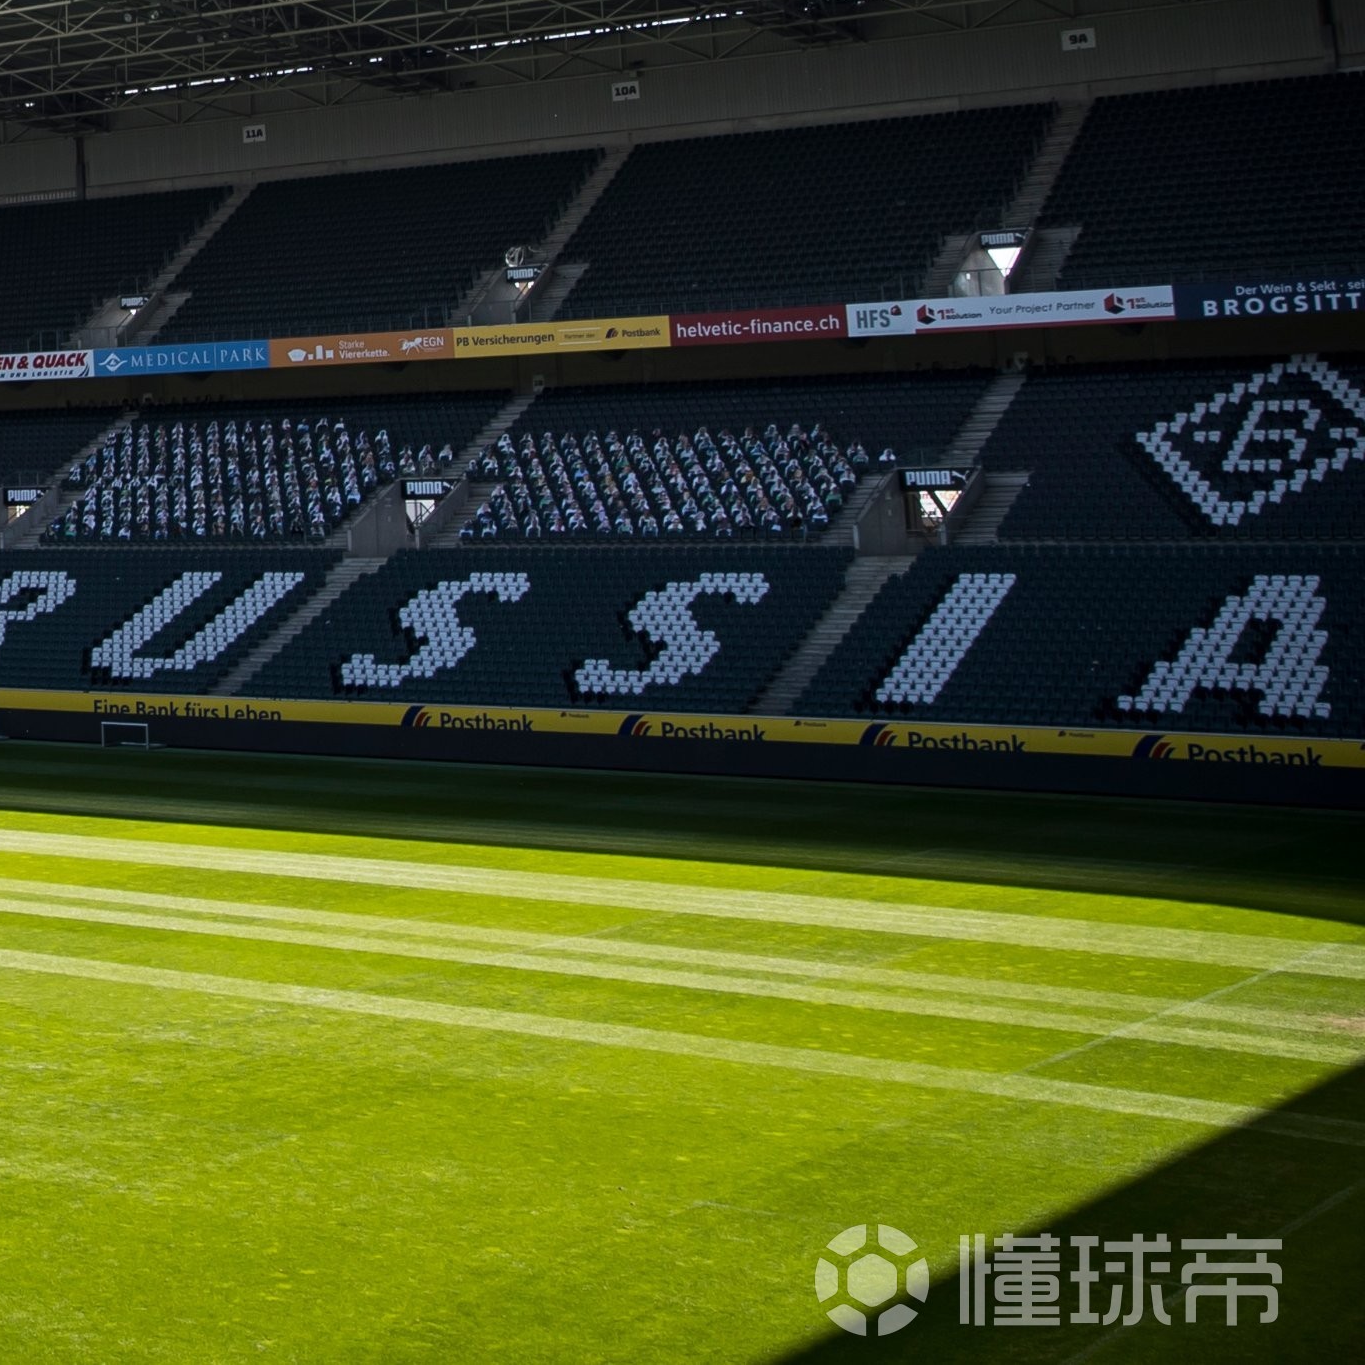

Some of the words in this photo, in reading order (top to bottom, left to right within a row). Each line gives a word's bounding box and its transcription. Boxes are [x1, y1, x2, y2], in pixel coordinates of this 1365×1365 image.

[1069, 34, 1089, 45] 9A
[614, 86, 637, 97] 10A
[245, 129, 263, 139] 11A
[1235, 285, 1258, 296] Der
[1260, 283, 1292, 295] Wein
[1296, 281, 1306, 293] &
[1309, 279, 1337, 292] Sekt
[989, 306, 1015, 316] Your
[1016, 303, 1053, 315] Project
[1055, 301, 1096, 312] Partner
[676, 314, 840, 338] helvetic-finance.ch
[856, 309, 890, 329] HFS
[456, 337, 470, 348] PB
[472, 331, 555, 347] Versicherungen
[622, 327, 661, 338] Postbank
[339, 340, 365, 350] Starke
[422, 336, 445, 348] EGN
[18, 355, 30, 368] &
[32, 352, 88, 369] QUACK
[131, 350, 212, 368] MEDICAL
[221, 347, 267, 363] PARK
[339, 348, 391, 359] Viererkette.
[905, 470, 952, 486] PUMA
[406, 481, 443, 495] PUMA
[94, 699, 130, 714] Eine
[136, 701, 179, 716] Bank
[440, 712, 534, 732] Postbank
[662, 722, 766, 741] Postbank
[908, 731, 1026, 752] Postbank
[1187, 743, 1323, 767] Postbank
